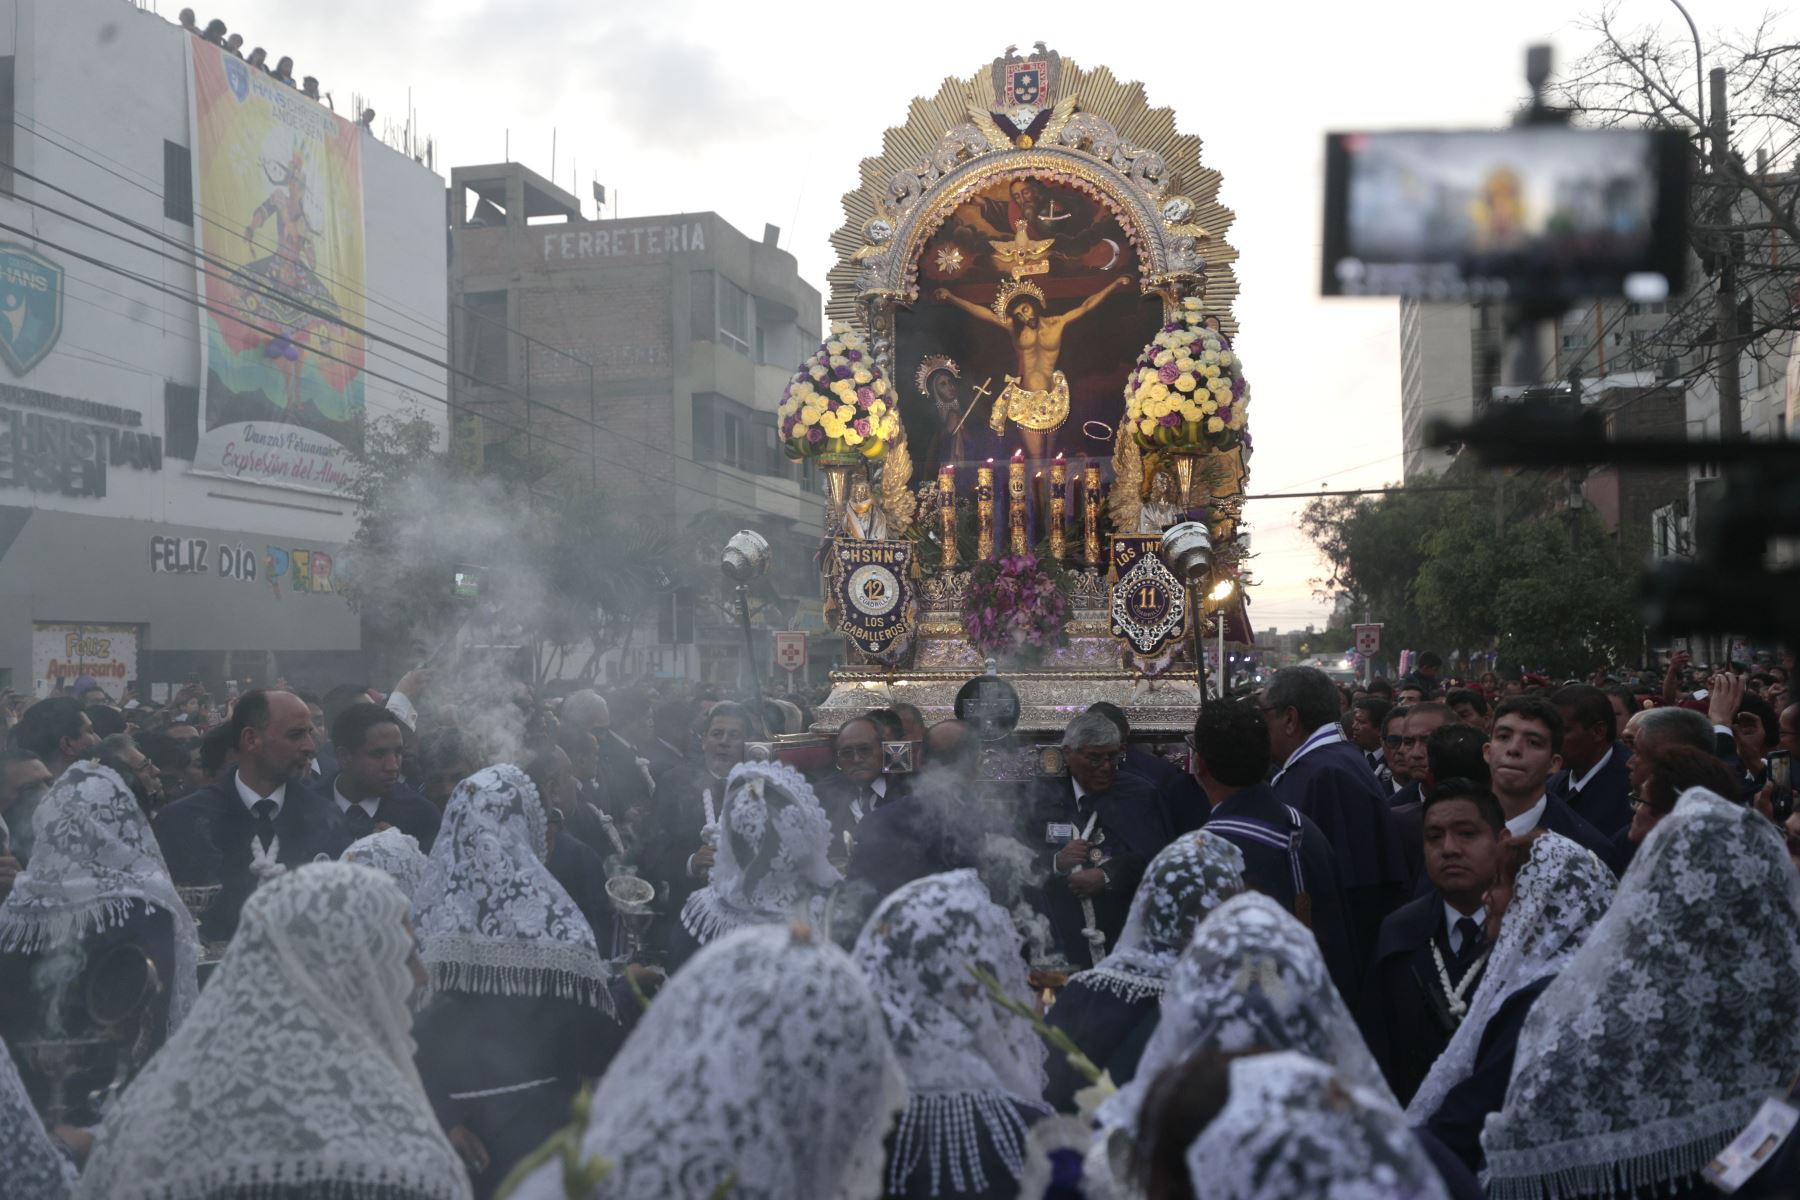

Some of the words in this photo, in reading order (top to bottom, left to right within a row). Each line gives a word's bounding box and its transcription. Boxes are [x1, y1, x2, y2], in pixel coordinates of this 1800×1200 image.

[544, 222, 705, 261] FERRETERIA
[291, 456, 315, 480] del
[150, 535, 208, 573] FELIZ
[851, 549, 894, 563] HSMN
[1116, 547, 1136, 567] LOS
[865, 580, 883, 600] 12
[1138, 587, 1156, 608] 11
[859, 594, 891, 607] CUADRILLA
[843, 621, 905, 641] CABALLEROS
[865, 617, 885, 627] LOS
[65, 632, 111, 659] Feliz
